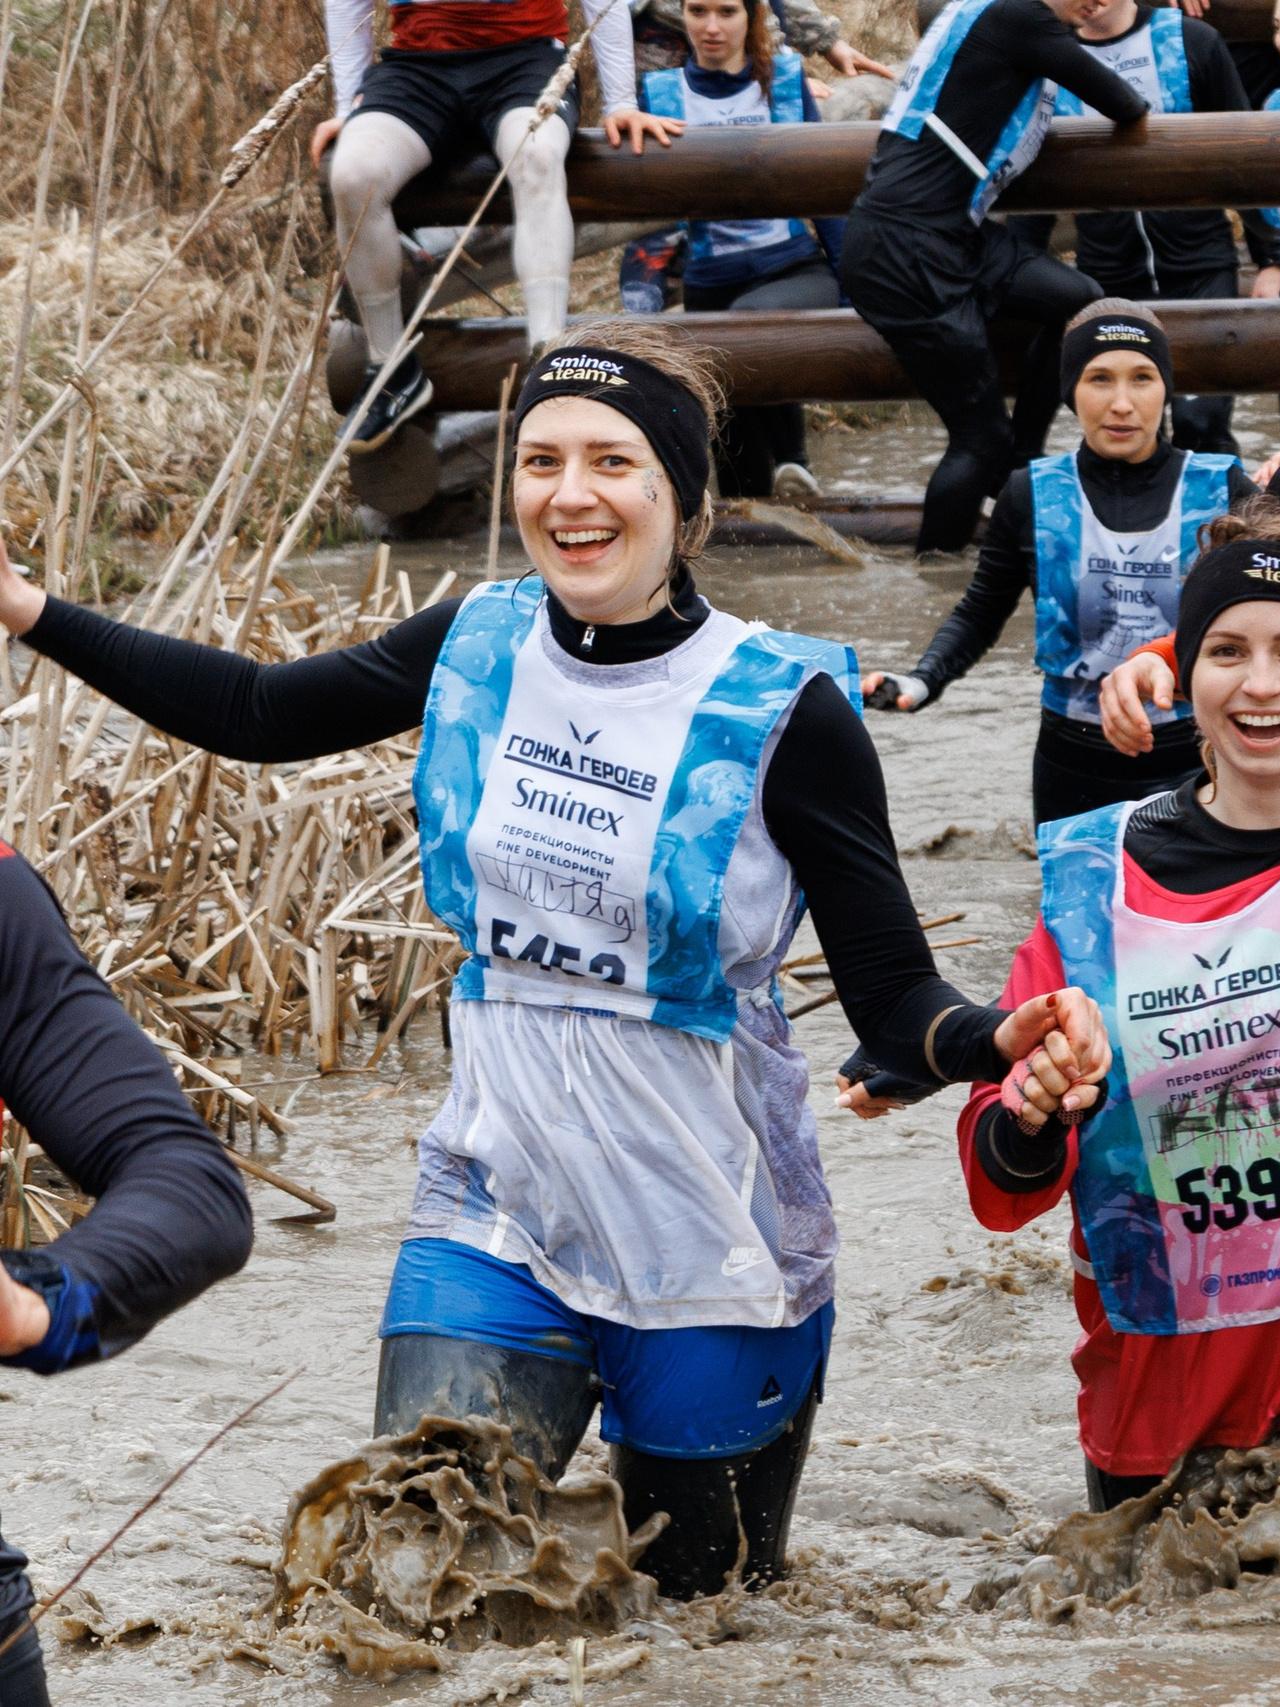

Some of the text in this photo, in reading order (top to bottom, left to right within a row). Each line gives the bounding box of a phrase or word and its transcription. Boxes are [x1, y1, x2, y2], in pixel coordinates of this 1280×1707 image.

[1098, 323, 1146, 336] Sminex
[1107, 333, 1139, 341] team
[550, 354, 624, 375] Sminex
[555, 367, 607, 381] team
[1123, 562, 1172, 574] ГЕРОЕВ
[1101, 580, 1156, 604] Sinex
[506, 734, 658, 794] ГОНКА ГЕРОЕВ
[511, 777, 624, 837] Sminex
[502, 824, 615, 866] ПЕРФЕКЦИОНИСТЫ
[496, 840, 611, 881] FINE DEVELOPMENT
[1128, 984, 1207, 1012] ГОНКА
[1170, 1089, 1199, 1104] FINE
[727, 1247, 760, 1264] NIKE
[757, 1393, 783, 1408] Reebok
